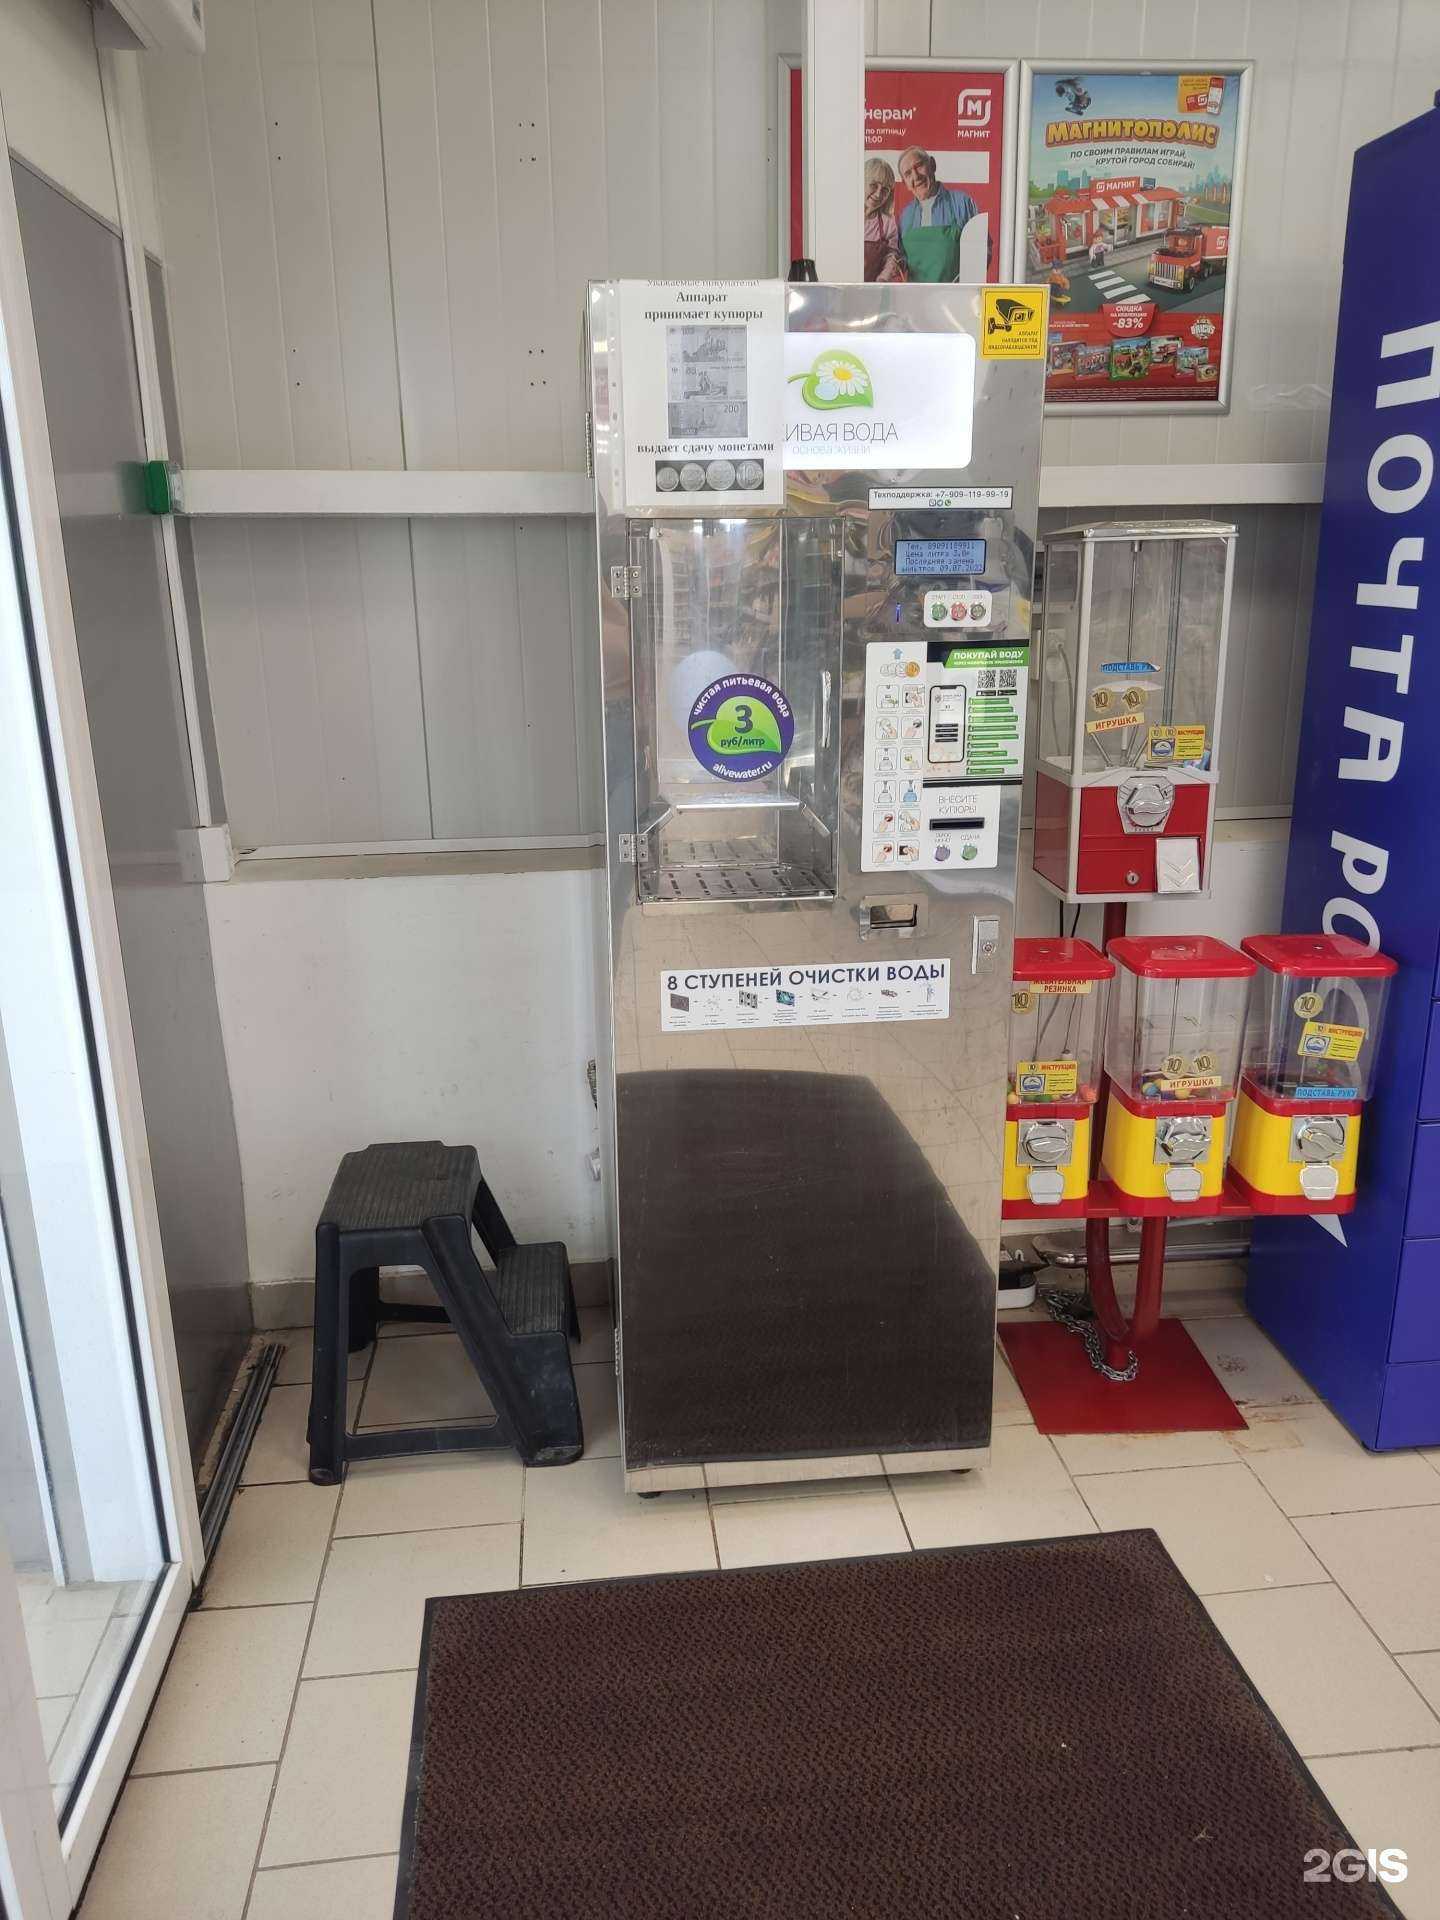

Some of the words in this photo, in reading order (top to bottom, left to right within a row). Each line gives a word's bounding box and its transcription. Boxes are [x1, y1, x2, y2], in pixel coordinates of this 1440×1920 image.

[864, 107, 917, 123] нерам
[876, 128, 906, 137] пятницу
[957, 130, 991, 138] МАГНИТ
[1047, 119, 1219, 146] МАГНИТОПОЛИС
[1070, 151, 1083, 159] ПО
[1083, 148, 1113, 157] СВОИМ
[1114, 147, 1159, 155] ПРАВИЛАМ
[1160, 148, 1187, 158] ИГРАЙ,
[1095, 156, 1128, 166] КРУТОЙ
[1128, 157, 1156, 166] ГОРОД
[1157, 158, 1196, 169] СОБИРАЙ!
[1106, 181, 1137, 190] МАГНИТ
[676, 291, 729, 304] Аппарат
[1115, 305, 1143, 313] СКИДКА
[645, 309, 711, 322] принимает
[713, 311, 764, 322] купюры
[1112, 317, 1144, 329] -83%
[784, 423, 838, 441] ИВАЯ
[843, 422, 899, 444] ВОДА
[637, 443, 679, 454] выдает
[682, 443, 714, 455] сдачу
[716, 442, 775, 452] монетами
[873, 490, 933, 500] Техподдержка:
[935, 490, 1009, 499] +7-909-119-99-19
[1337, 321, 1440, 782] ПОЧТА
[953, 650, 998, 660] ПОКУПАЙ
[999, 650, 1024, 660] ВОДУ
[693, 684, 722, 716] чистая
[722, 676, 773, 695] питьевая
[771, 691, 790, 718] вода
[734, 704, 754, 734] 3
[1095, 716, 1138, 730] ИГРУШКА
[720, 736, 766, 748] руб/литр
[712, 761, 773, 779] alivewater.ru
[938, 794, 978, 804] ВНЕСИТЕ
[938, 805, 977, 815] КУПЮРЫ
[668, 977, 678, 990] 8
[684, 968, 783, 990] СТУПЕНЕЙ
[788, 967, 880, 986] ОЧИСТКИ
[886, 964, 945, 982] ВОДЫ
[1169, 1078, 1214, 1088] ИГРУШКА
[1297, 1088, 1335, 1097] ПОДСТАВЬ
